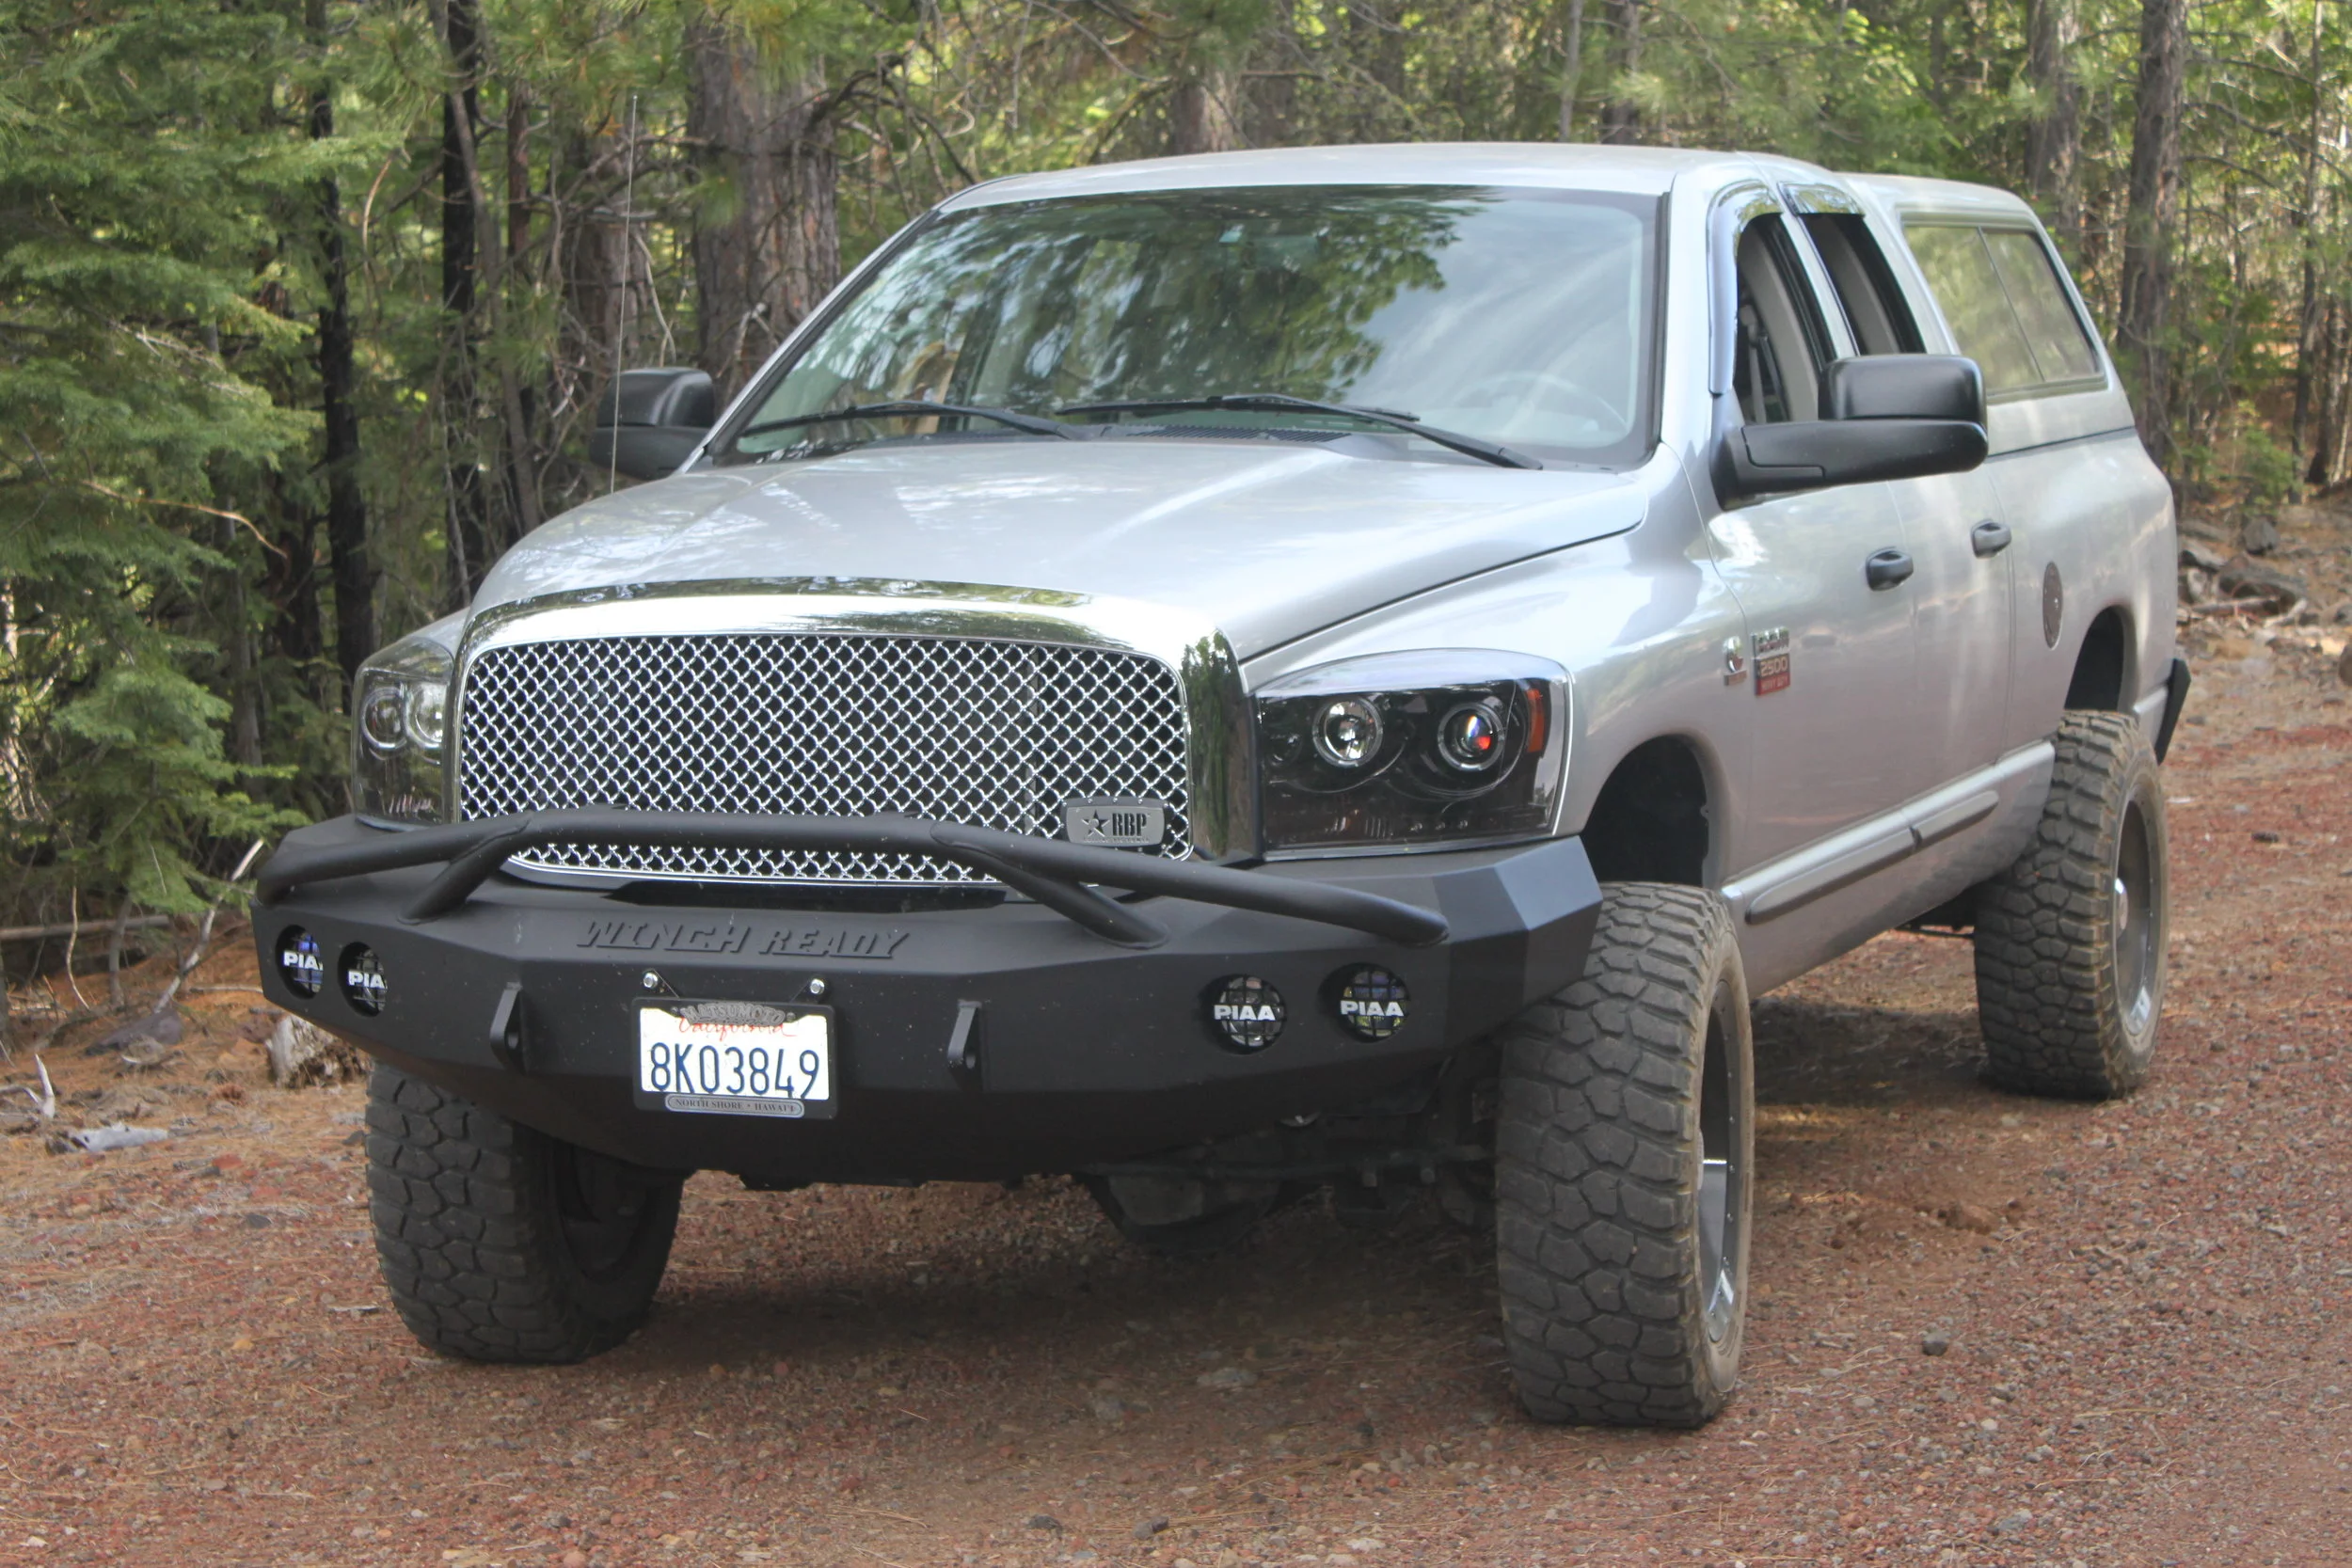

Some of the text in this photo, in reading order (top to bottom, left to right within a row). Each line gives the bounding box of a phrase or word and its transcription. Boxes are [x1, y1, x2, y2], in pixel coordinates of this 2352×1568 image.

[1760, 657, 1788, 677] 2500
[1112, 813, 1147, 836] RBP
[577, 921, 911, 959] WINCH READY
[347, 970, 388, 990] PIA
[1214, 1004, 1276, 1022] PIAA
[1340, 1000, 1404, 1017] PIAA
[650, 1041, 819, 1099] 8K03849
[675, 1098, 709, 1108] NORTH
[711, 1101, 743, 1111] SHORE
